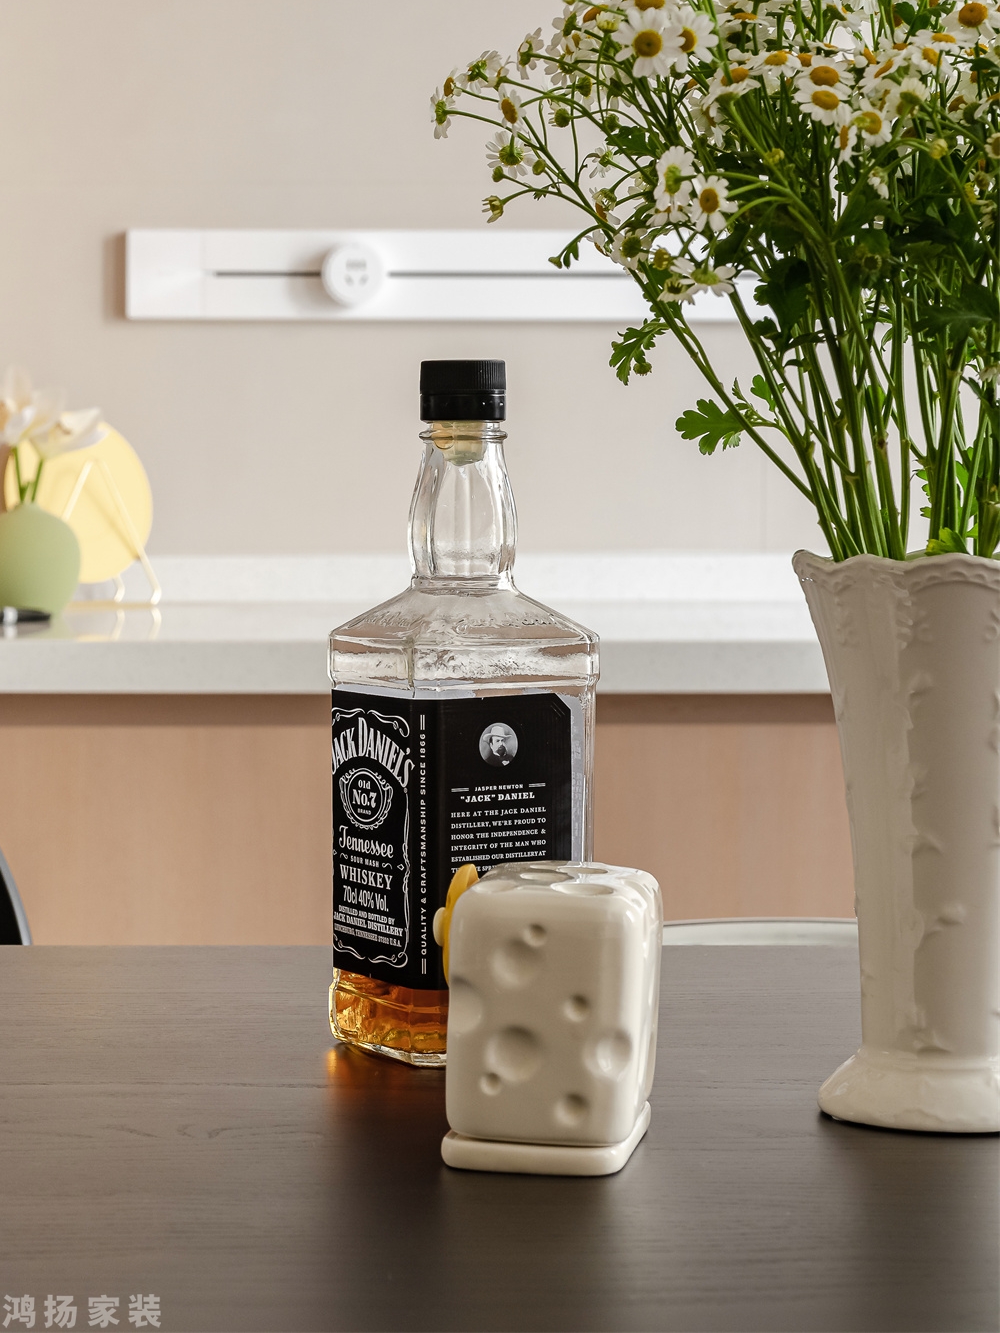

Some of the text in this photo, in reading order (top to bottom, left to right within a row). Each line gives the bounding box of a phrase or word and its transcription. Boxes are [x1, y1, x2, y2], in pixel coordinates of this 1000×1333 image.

[332, 717, 416, 788] JACK DANIEL'S
[358, 779, 371, 790] Old
[419, 762, 427, 795] SINCE
[497, 792, 535, 801] DANIEL
[357, 808, 372, 816] BRAND
[500, 808, 518, 816] JACK
[520, 806, 547, 814] DANIEL
[451, 821, 491, 829] DISTILLERY,
[492, 819, 512, 827] WE'RE
[490, 828, 539, 838] INDEPENDENCE
[339, 825, 394, 859] Tennessee
[451, 843, 488, 851] INTEGRITY
[350, 855, 380, 868] SOUR MASH
[451, 854, 491, 863] ESTABLISHED
[505, 851, 537, 859] DISTILLERY
[340, 863, 393, 890] WHISKEY
[343, 885, 389, 912] 70cl 40% Vol.
[338, 904, 396, 925] DISTILLED AND BOTTLED BY
[333, 911, 404, 937] JACK DANIEL DISTILLERY
